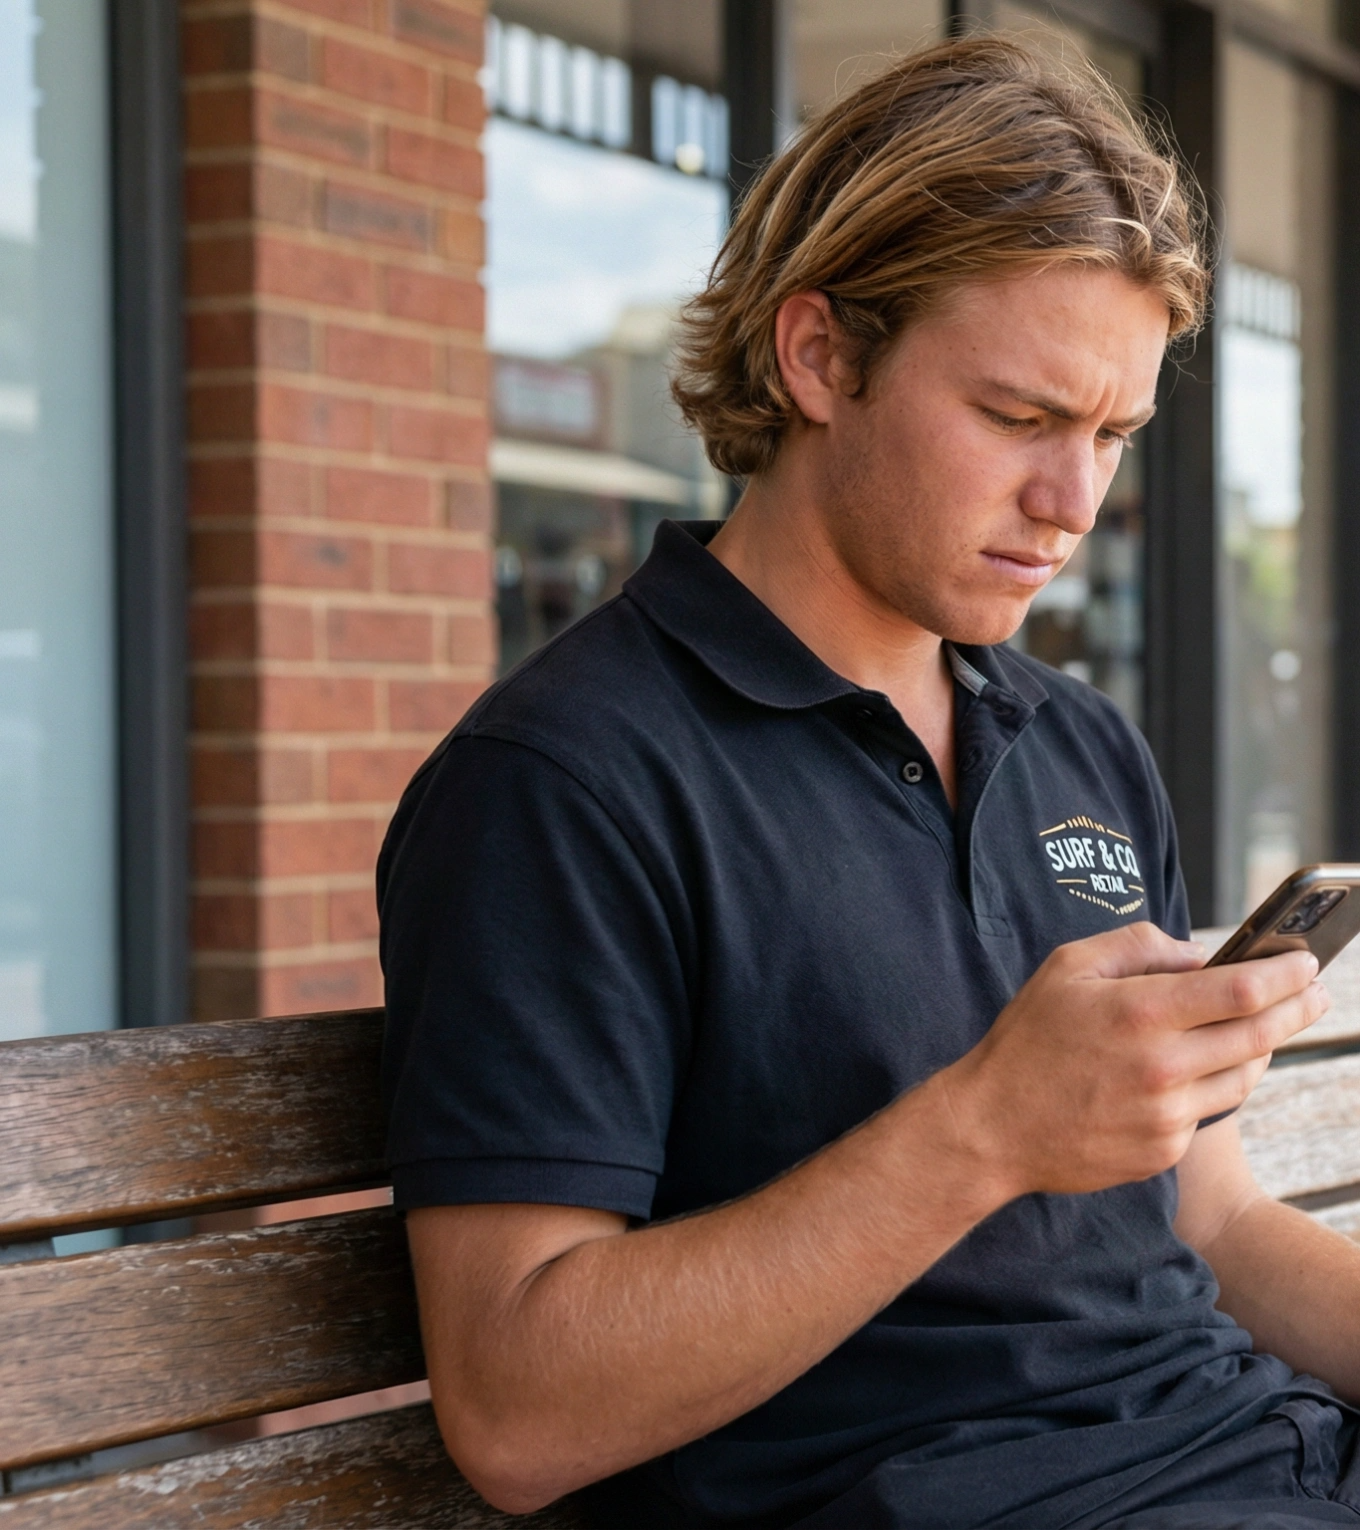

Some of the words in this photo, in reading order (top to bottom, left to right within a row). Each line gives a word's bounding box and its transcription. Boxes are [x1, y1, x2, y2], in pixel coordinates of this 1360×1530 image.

[1045, 837, 1095, 872] SURF
[1098, 839, 1117, 871] &
[1089, 873, 1129, 894] RETAIL
